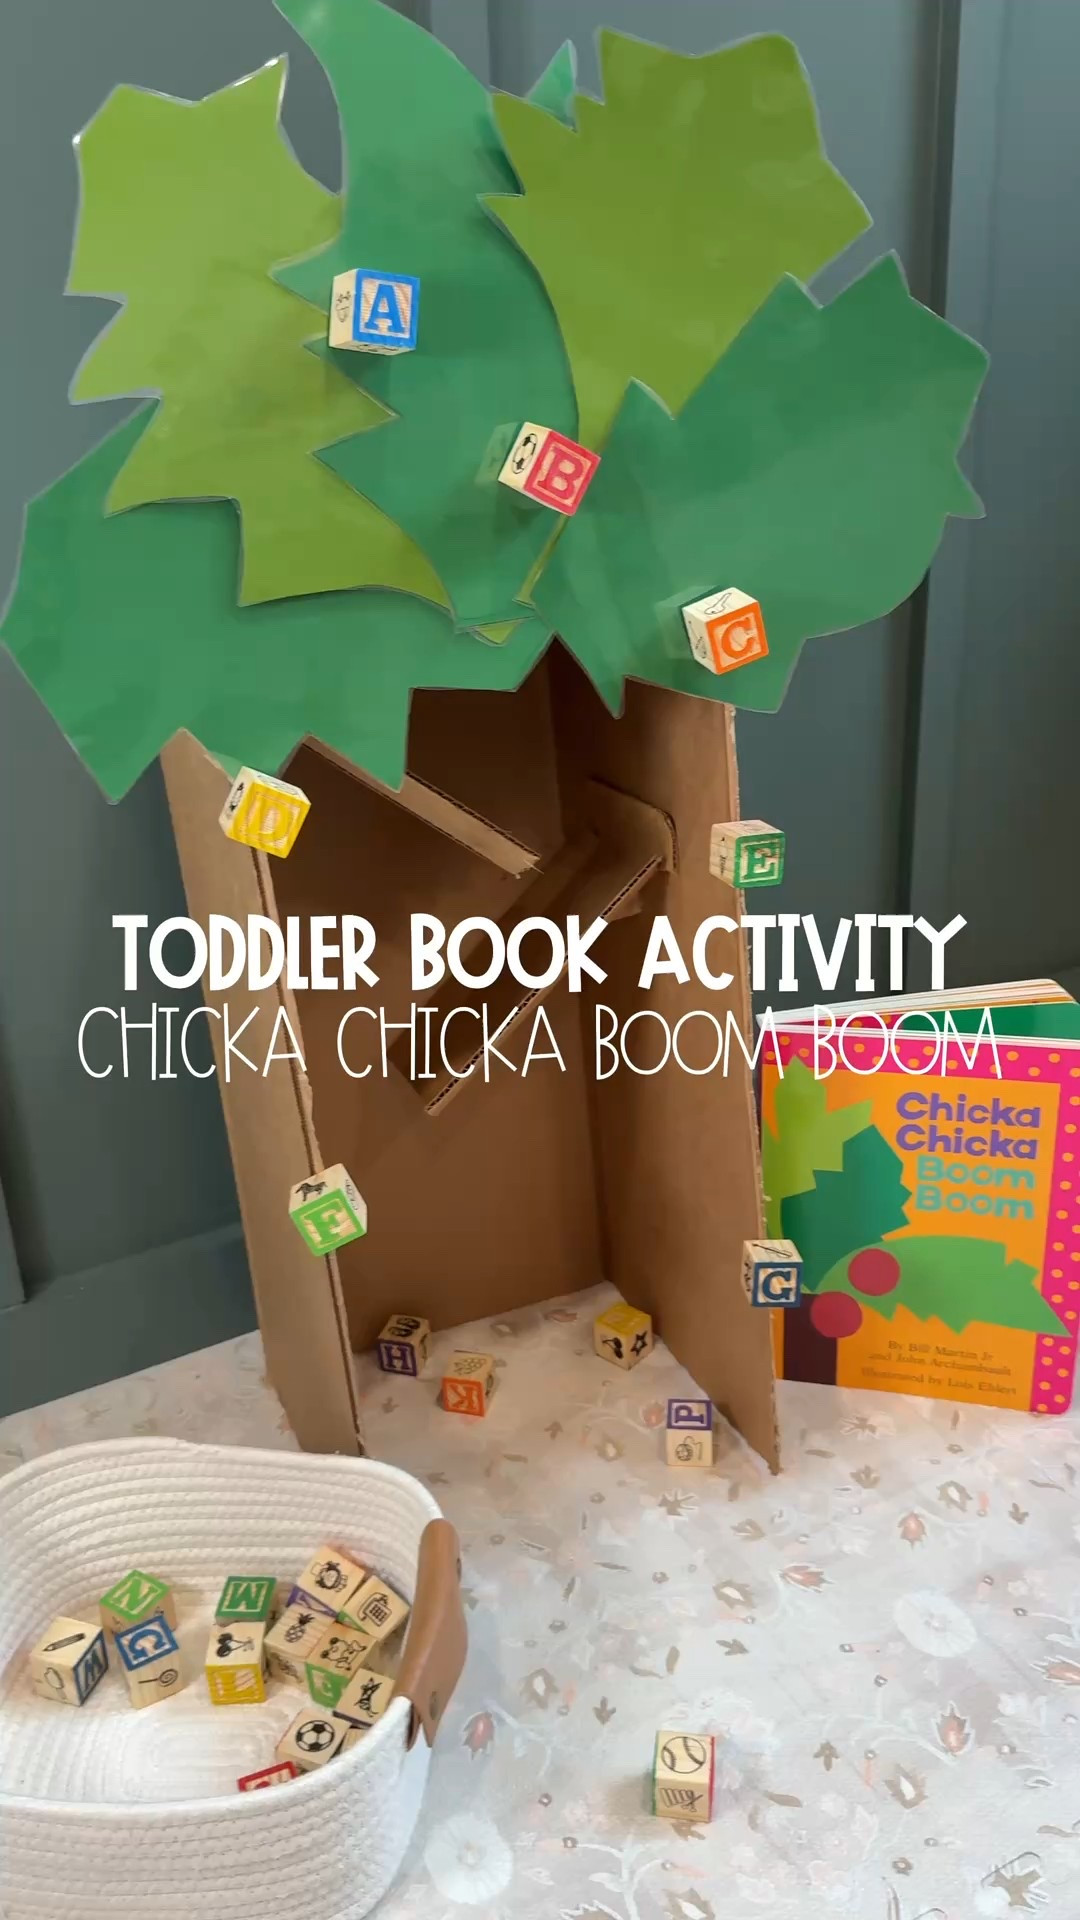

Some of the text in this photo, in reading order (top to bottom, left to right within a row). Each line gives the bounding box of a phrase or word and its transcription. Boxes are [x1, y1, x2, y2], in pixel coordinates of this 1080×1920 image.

[363, 283, 407, 334] A
[538, 448, 584, 501] B
[720, 618, 759, 660] C
[244, 791, 294, 846] D
[743, 841, 777, 880] E
[896, 1091, 1041, 1128] Chicka
[896, 1124, 1038, 1160] Chicka
[916, 1154, 1036, 1191] Boom
[915, 1183, 1035, 1221] Boom
[303, 1200, 344, 1247] F
[762, 1270, 793, 1301] G
[383, 1344, 412, 1371] H
[674, 1404, 705, 1425] P
